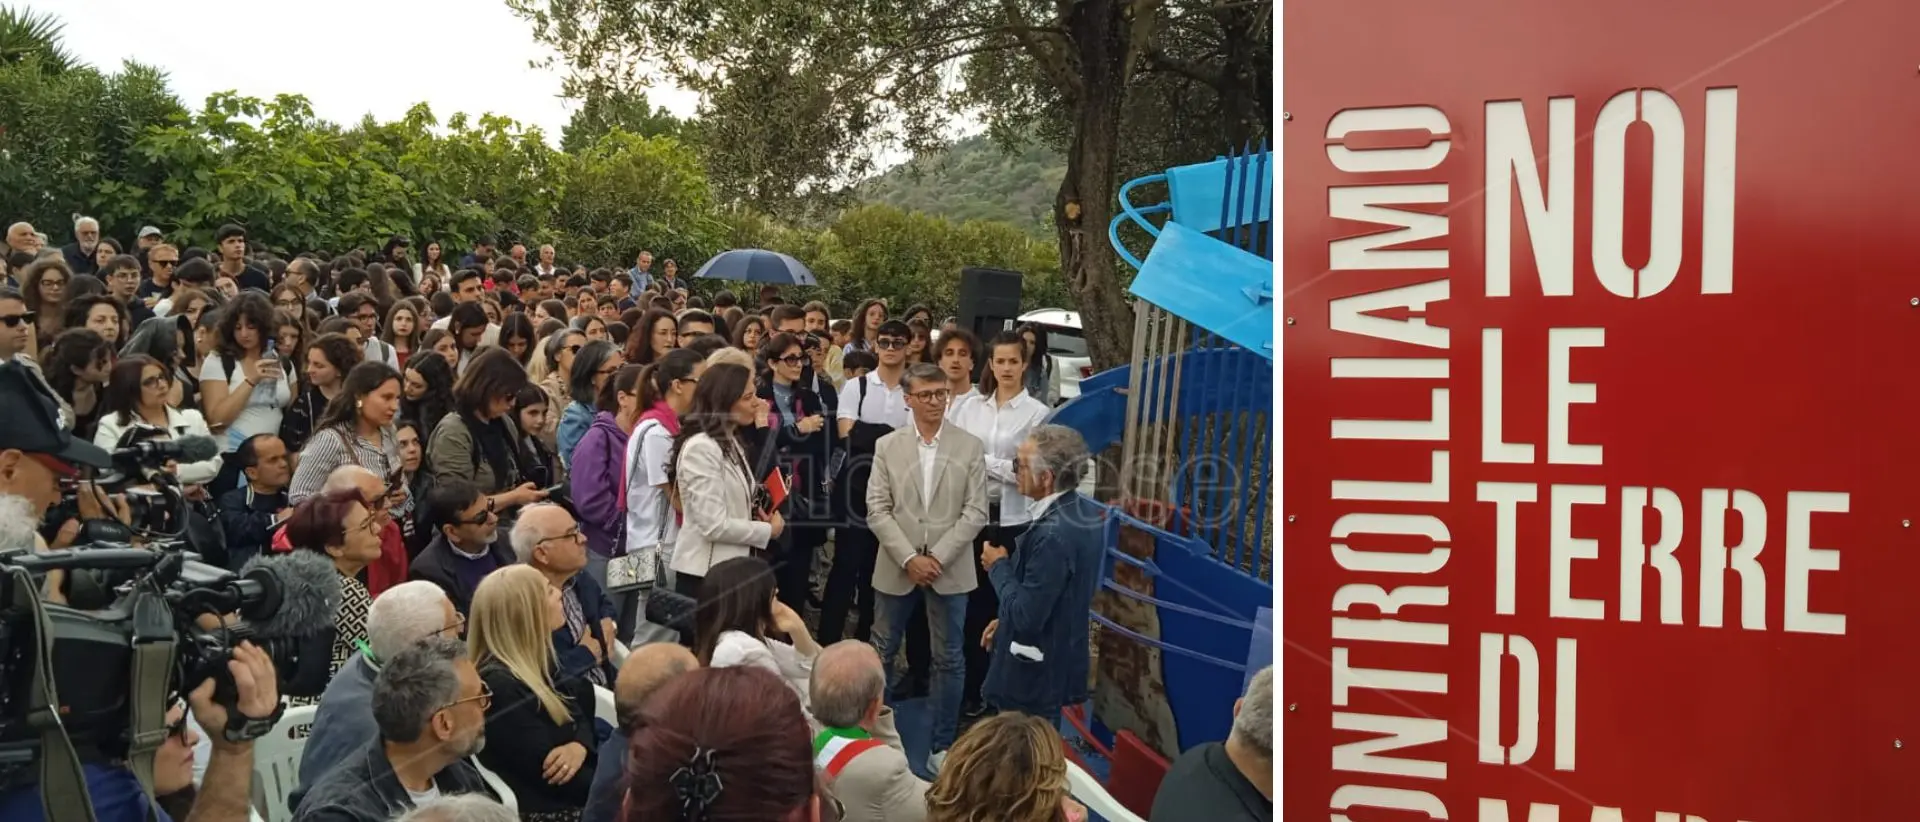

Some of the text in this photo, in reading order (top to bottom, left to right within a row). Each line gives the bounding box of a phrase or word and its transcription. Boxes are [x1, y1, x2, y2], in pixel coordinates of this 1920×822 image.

[1483, 87, 1738, 299] NOI
[1481, 328, 1605, 465] LE
[1476, 481, 1850, 635] TERRE
[1478, 632, 1577, 771] DI
